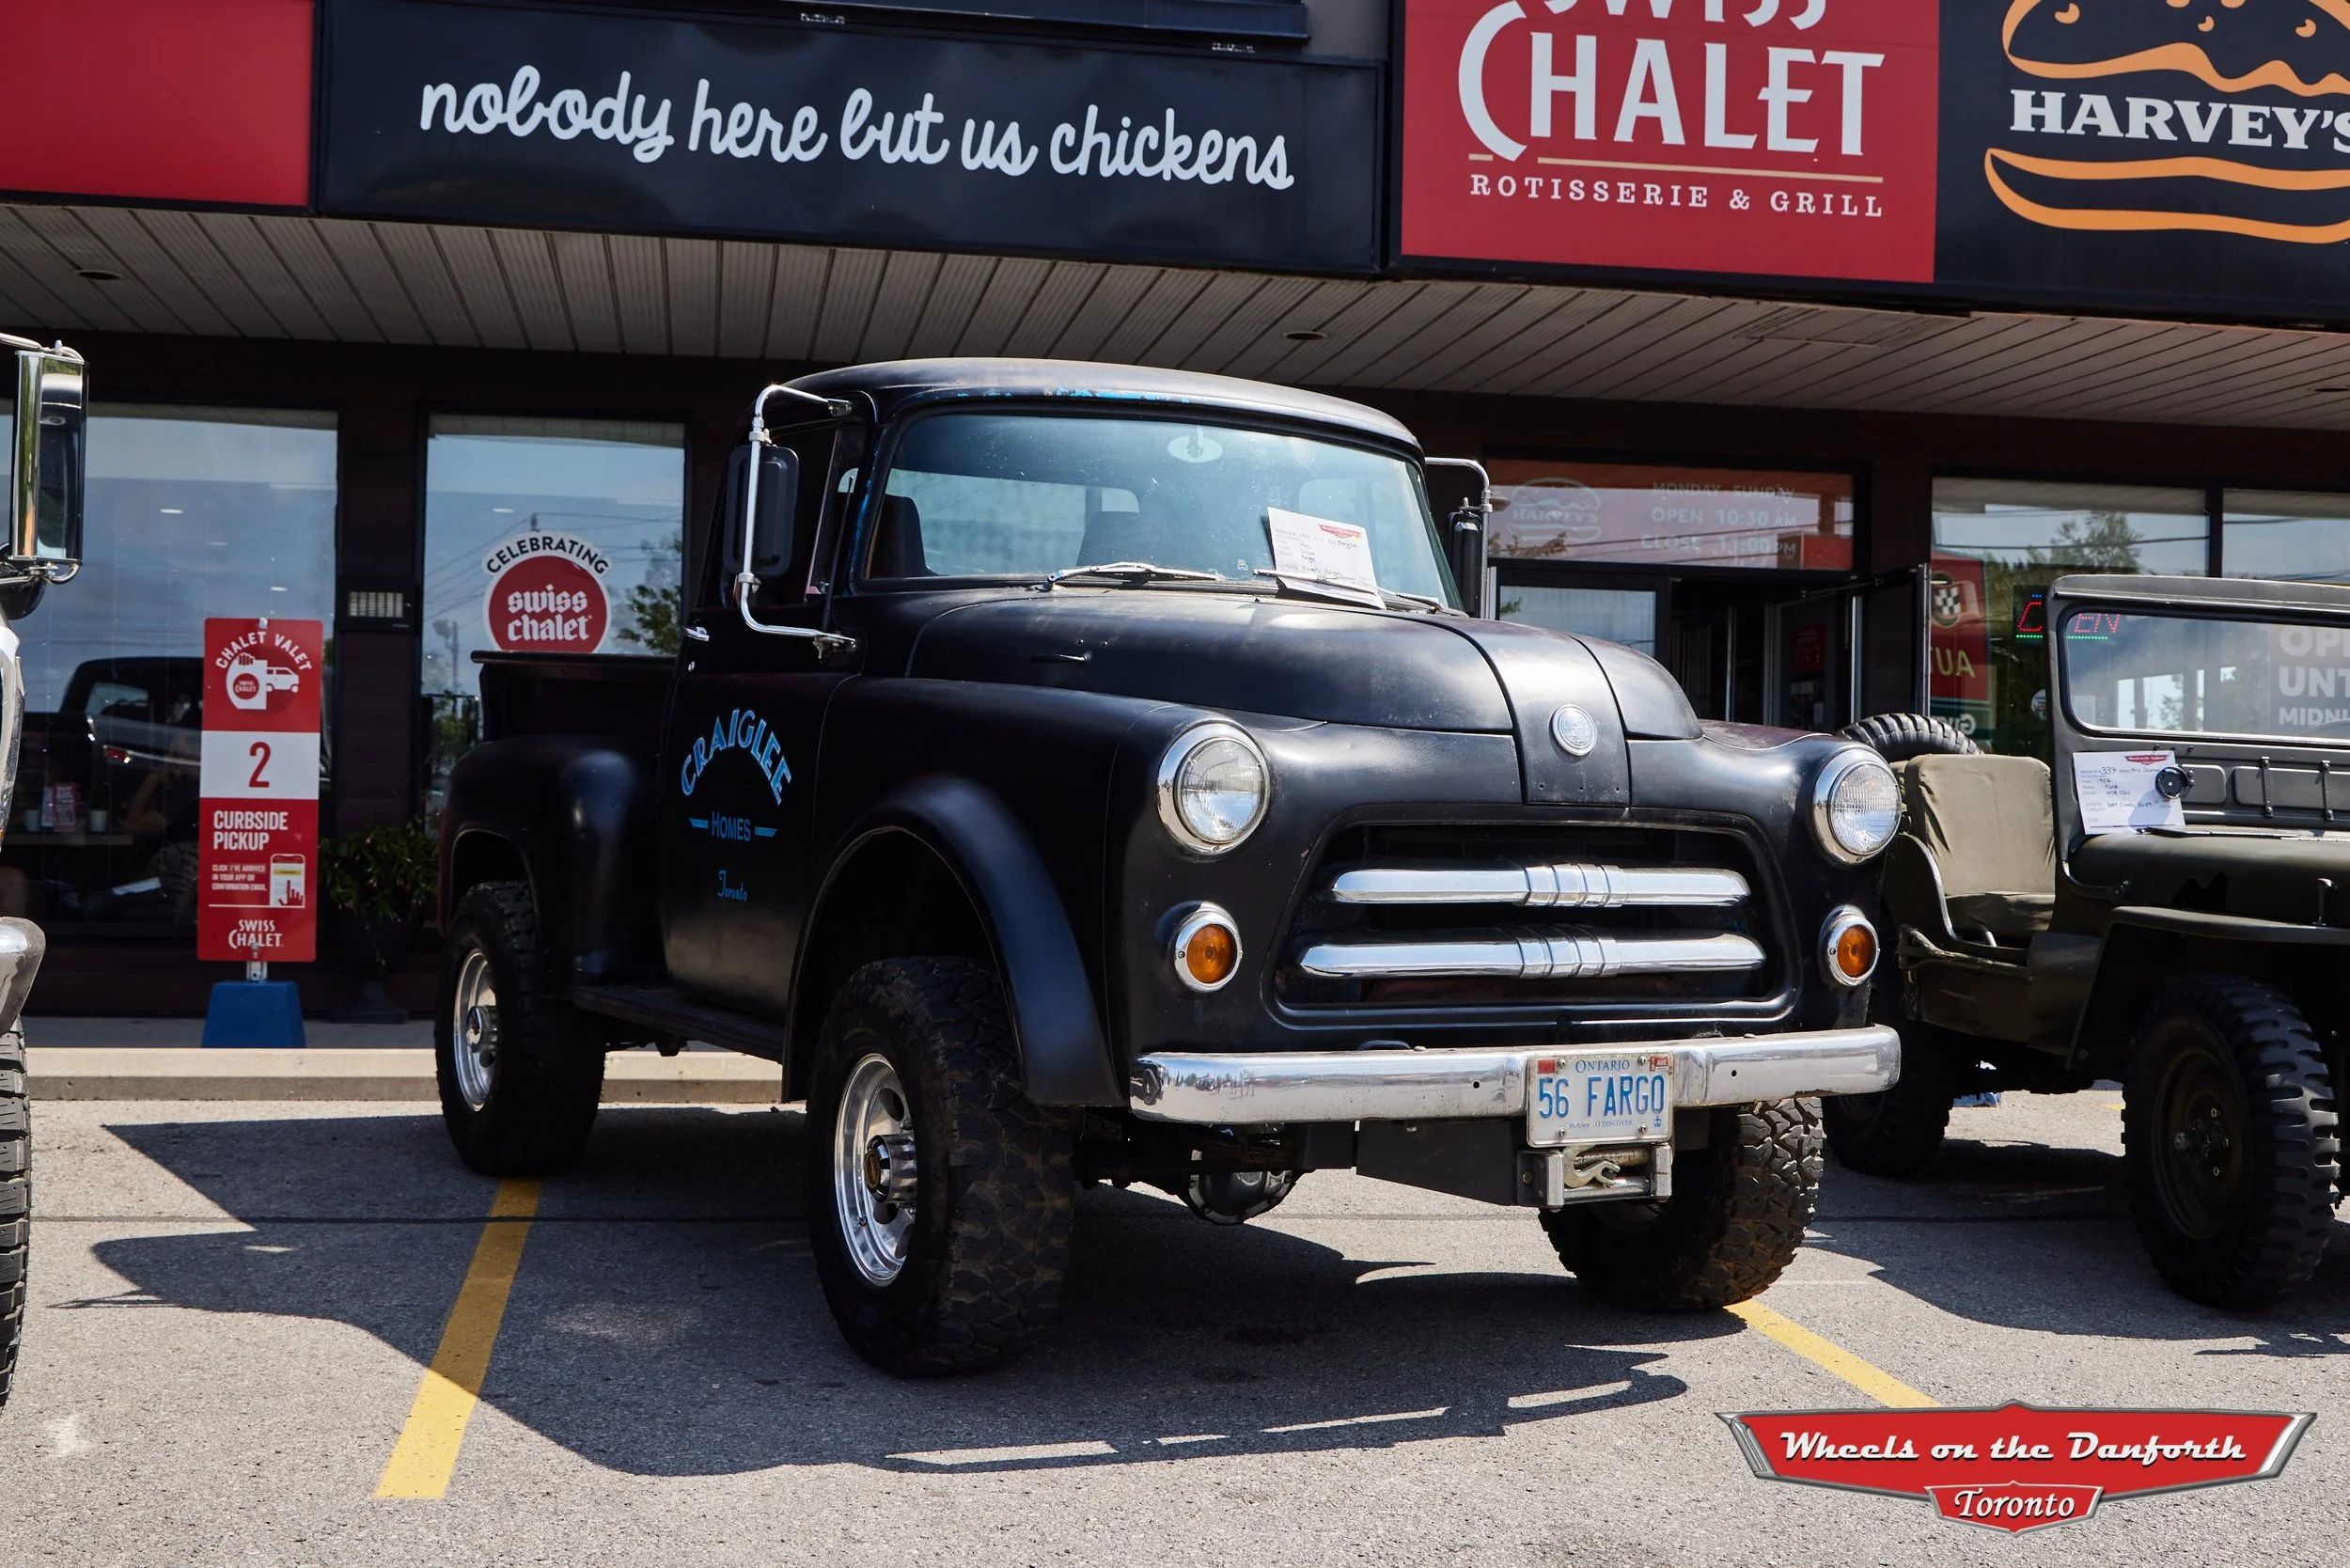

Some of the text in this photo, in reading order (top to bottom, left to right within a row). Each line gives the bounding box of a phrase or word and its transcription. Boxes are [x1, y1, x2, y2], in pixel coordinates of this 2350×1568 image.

[1458, 4, 1885, 162] CHALET
[420, 65, 1293, 190] nobody here but us chickens
[1470, 174, 1883, 218] ROTISSERIE & GRILL
[1653, 481, 1795, 499] MONDAY SUNDAY
[1651, 508, 1704, 525] OPEN
[1716, 509, 1768, 526] 10:30
[486, 536, 609, 574] CELEBRATING
[508, 584, 588, 613] swiss
[508, 614, 590, 641] chalet
[2018, 602, 2121, 633] OEN
[215, 631, 313, 671] CHALET VALET
[248, 741, 271, 788] 2
[682, 709, 791, 806] CRAIGLEE
[213, 810, 289, 830] CURBSIDE
[712, 810, 751, 842] HOMES
[213, 831, 270, 851] PICKUP
[229, 864, 241, 872] I'VE
[717, 870, 748, 902] Toronto
[228, 929, 283, 949] CHALET
[238, 919, 275, 933] SWISS
[1575, 1059, 1630, 1074] ONTARIO
[1539, 1074, 1665, 1119] 56 FARGO
